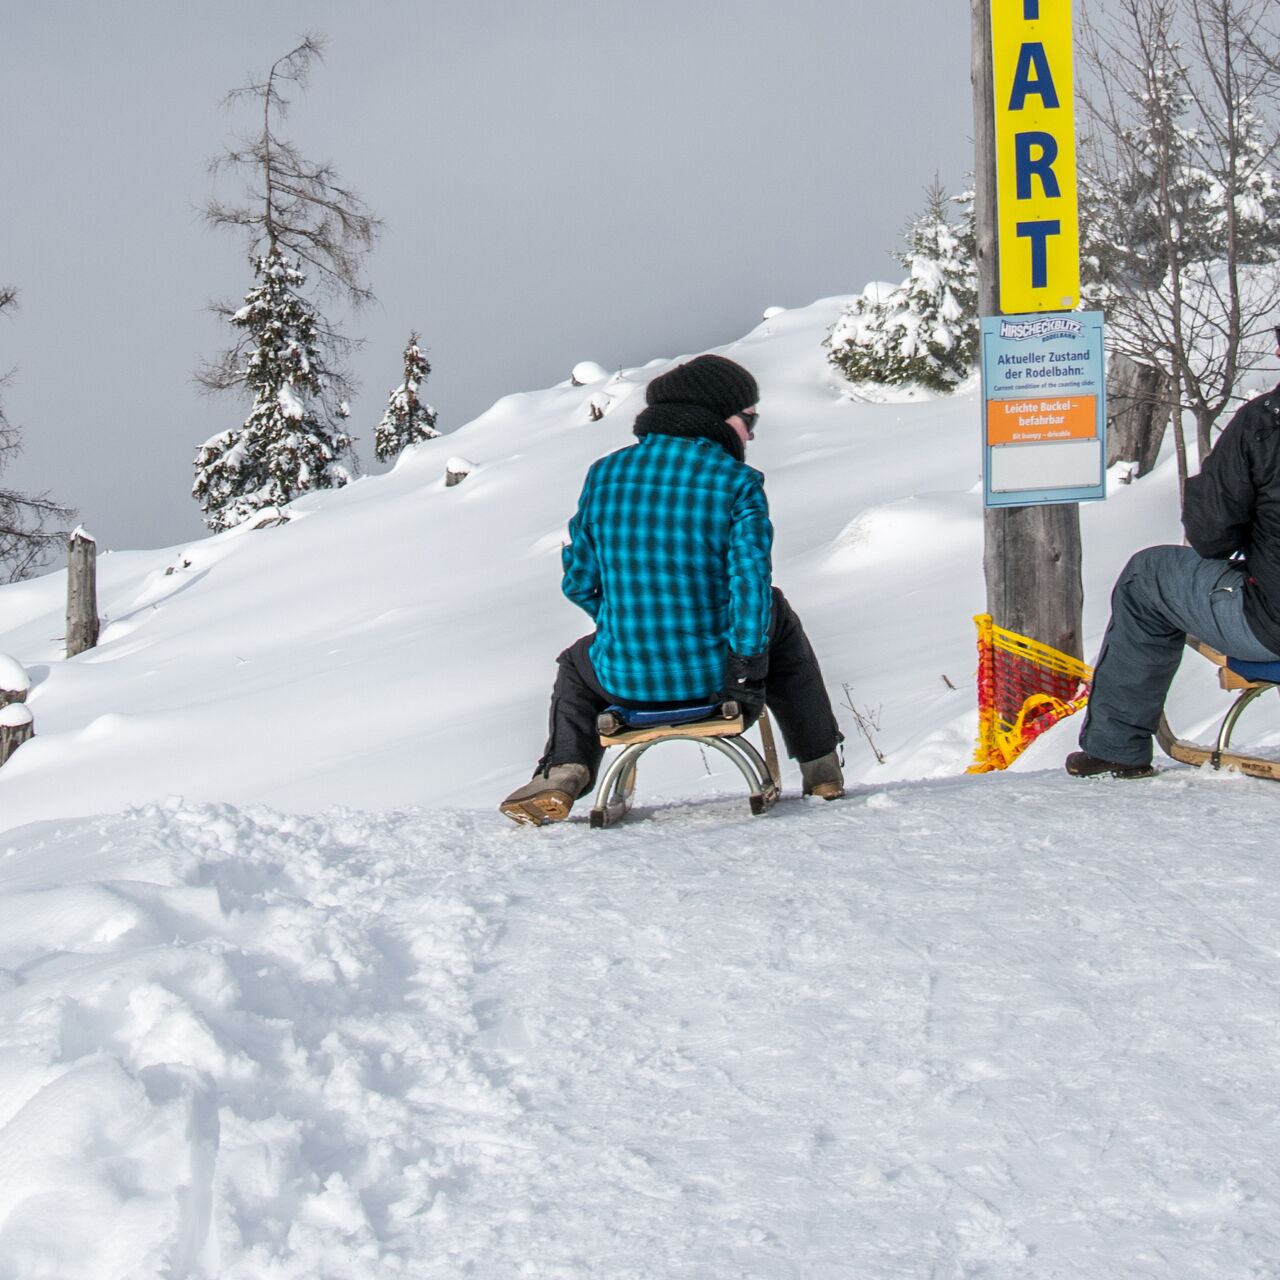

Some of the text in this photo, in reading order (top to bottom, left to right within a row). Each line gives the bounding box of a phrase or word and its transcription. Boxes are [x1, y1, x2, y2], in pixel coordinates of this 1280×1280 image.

[1000, 320, 1080, 338] HIRSCHECKBLITZ
[997, 349, 1090, 366] Aktueller Zustand
[1005, 365, 1085, 380] der Rodelbahn:
[1004, 403, 1039, 414] Leichte
[1039, 400, 1071, 412] Buckel
[1018, 414, 1065, 427] befahrbar
